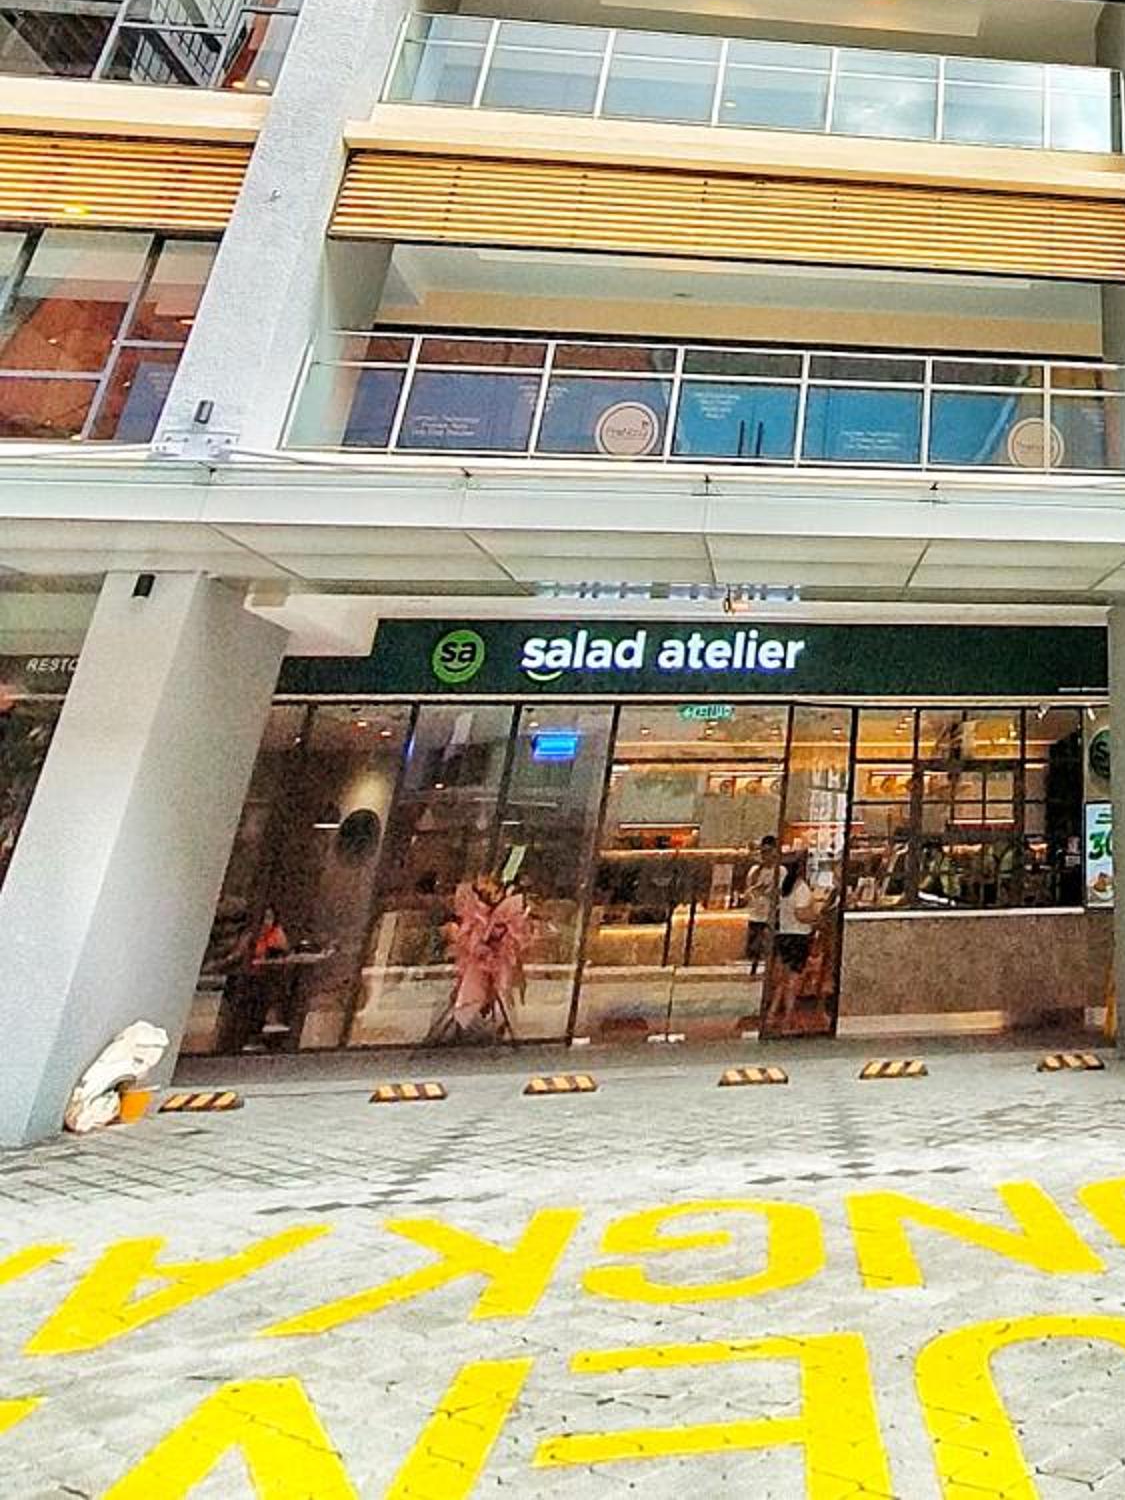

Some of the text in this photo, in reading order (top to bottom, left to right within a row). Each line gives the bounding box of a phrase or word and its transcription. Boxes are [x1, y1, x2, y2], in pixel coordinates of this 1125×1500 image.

[440, 641, 477, 661] sa
[521, 630, 804, 669] salad atelier
